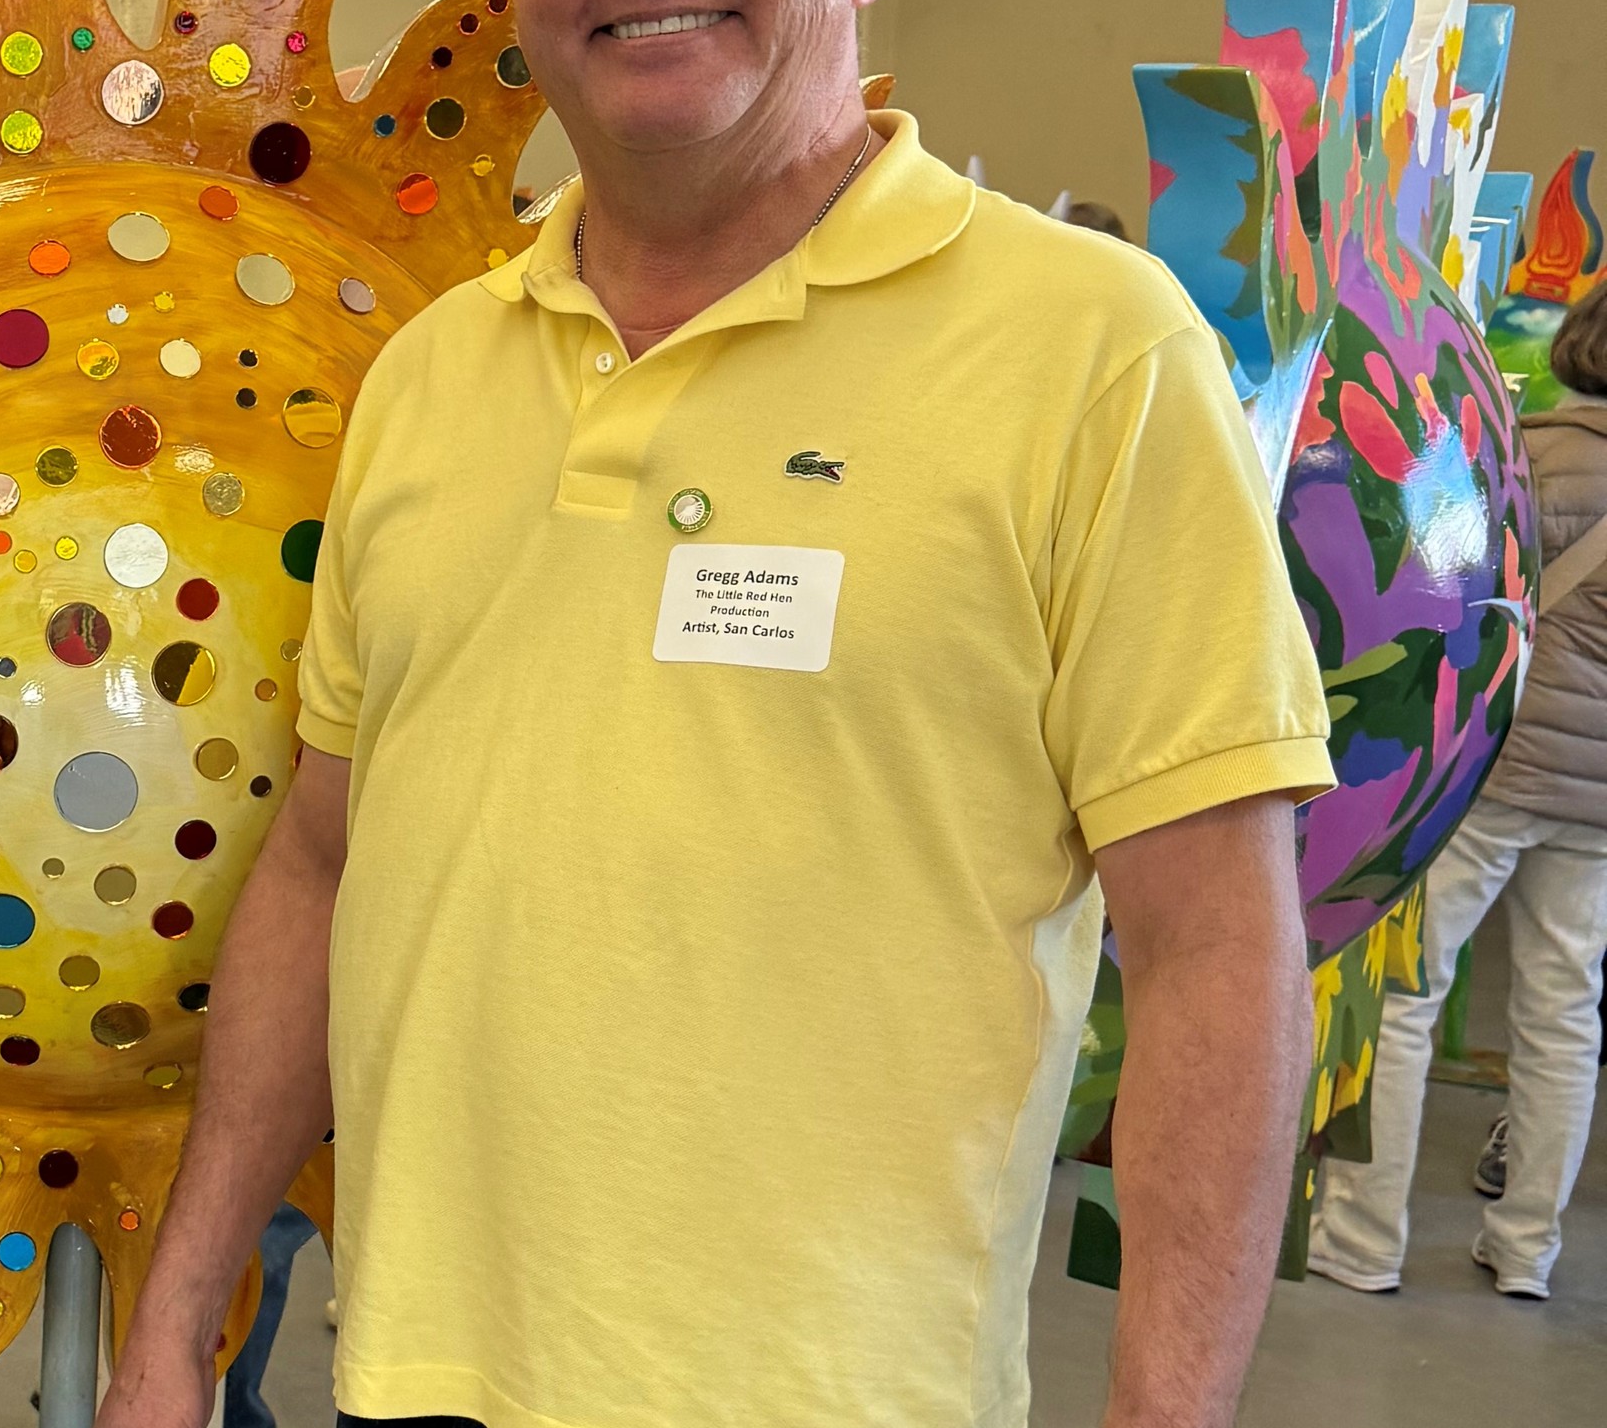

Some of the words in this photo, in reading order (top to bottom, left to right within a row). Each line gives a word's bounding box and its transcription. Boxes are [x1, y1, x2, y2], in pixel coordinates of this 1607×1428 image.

[696, 568, 740, 585] Gregg
[744, 570, 799, 586] Adams
[695, 589, 714, 599] The
[716, 590, 743, 600] Little
[746, 591, 768, 602] Red
[770, 592, 793, 603] Hen
[710, 605, 770, 618] Production
[682, 621, 720, 636] Artist,
[723, 623, 748, 635] San
[752, 625, 795, 639] Carlos
